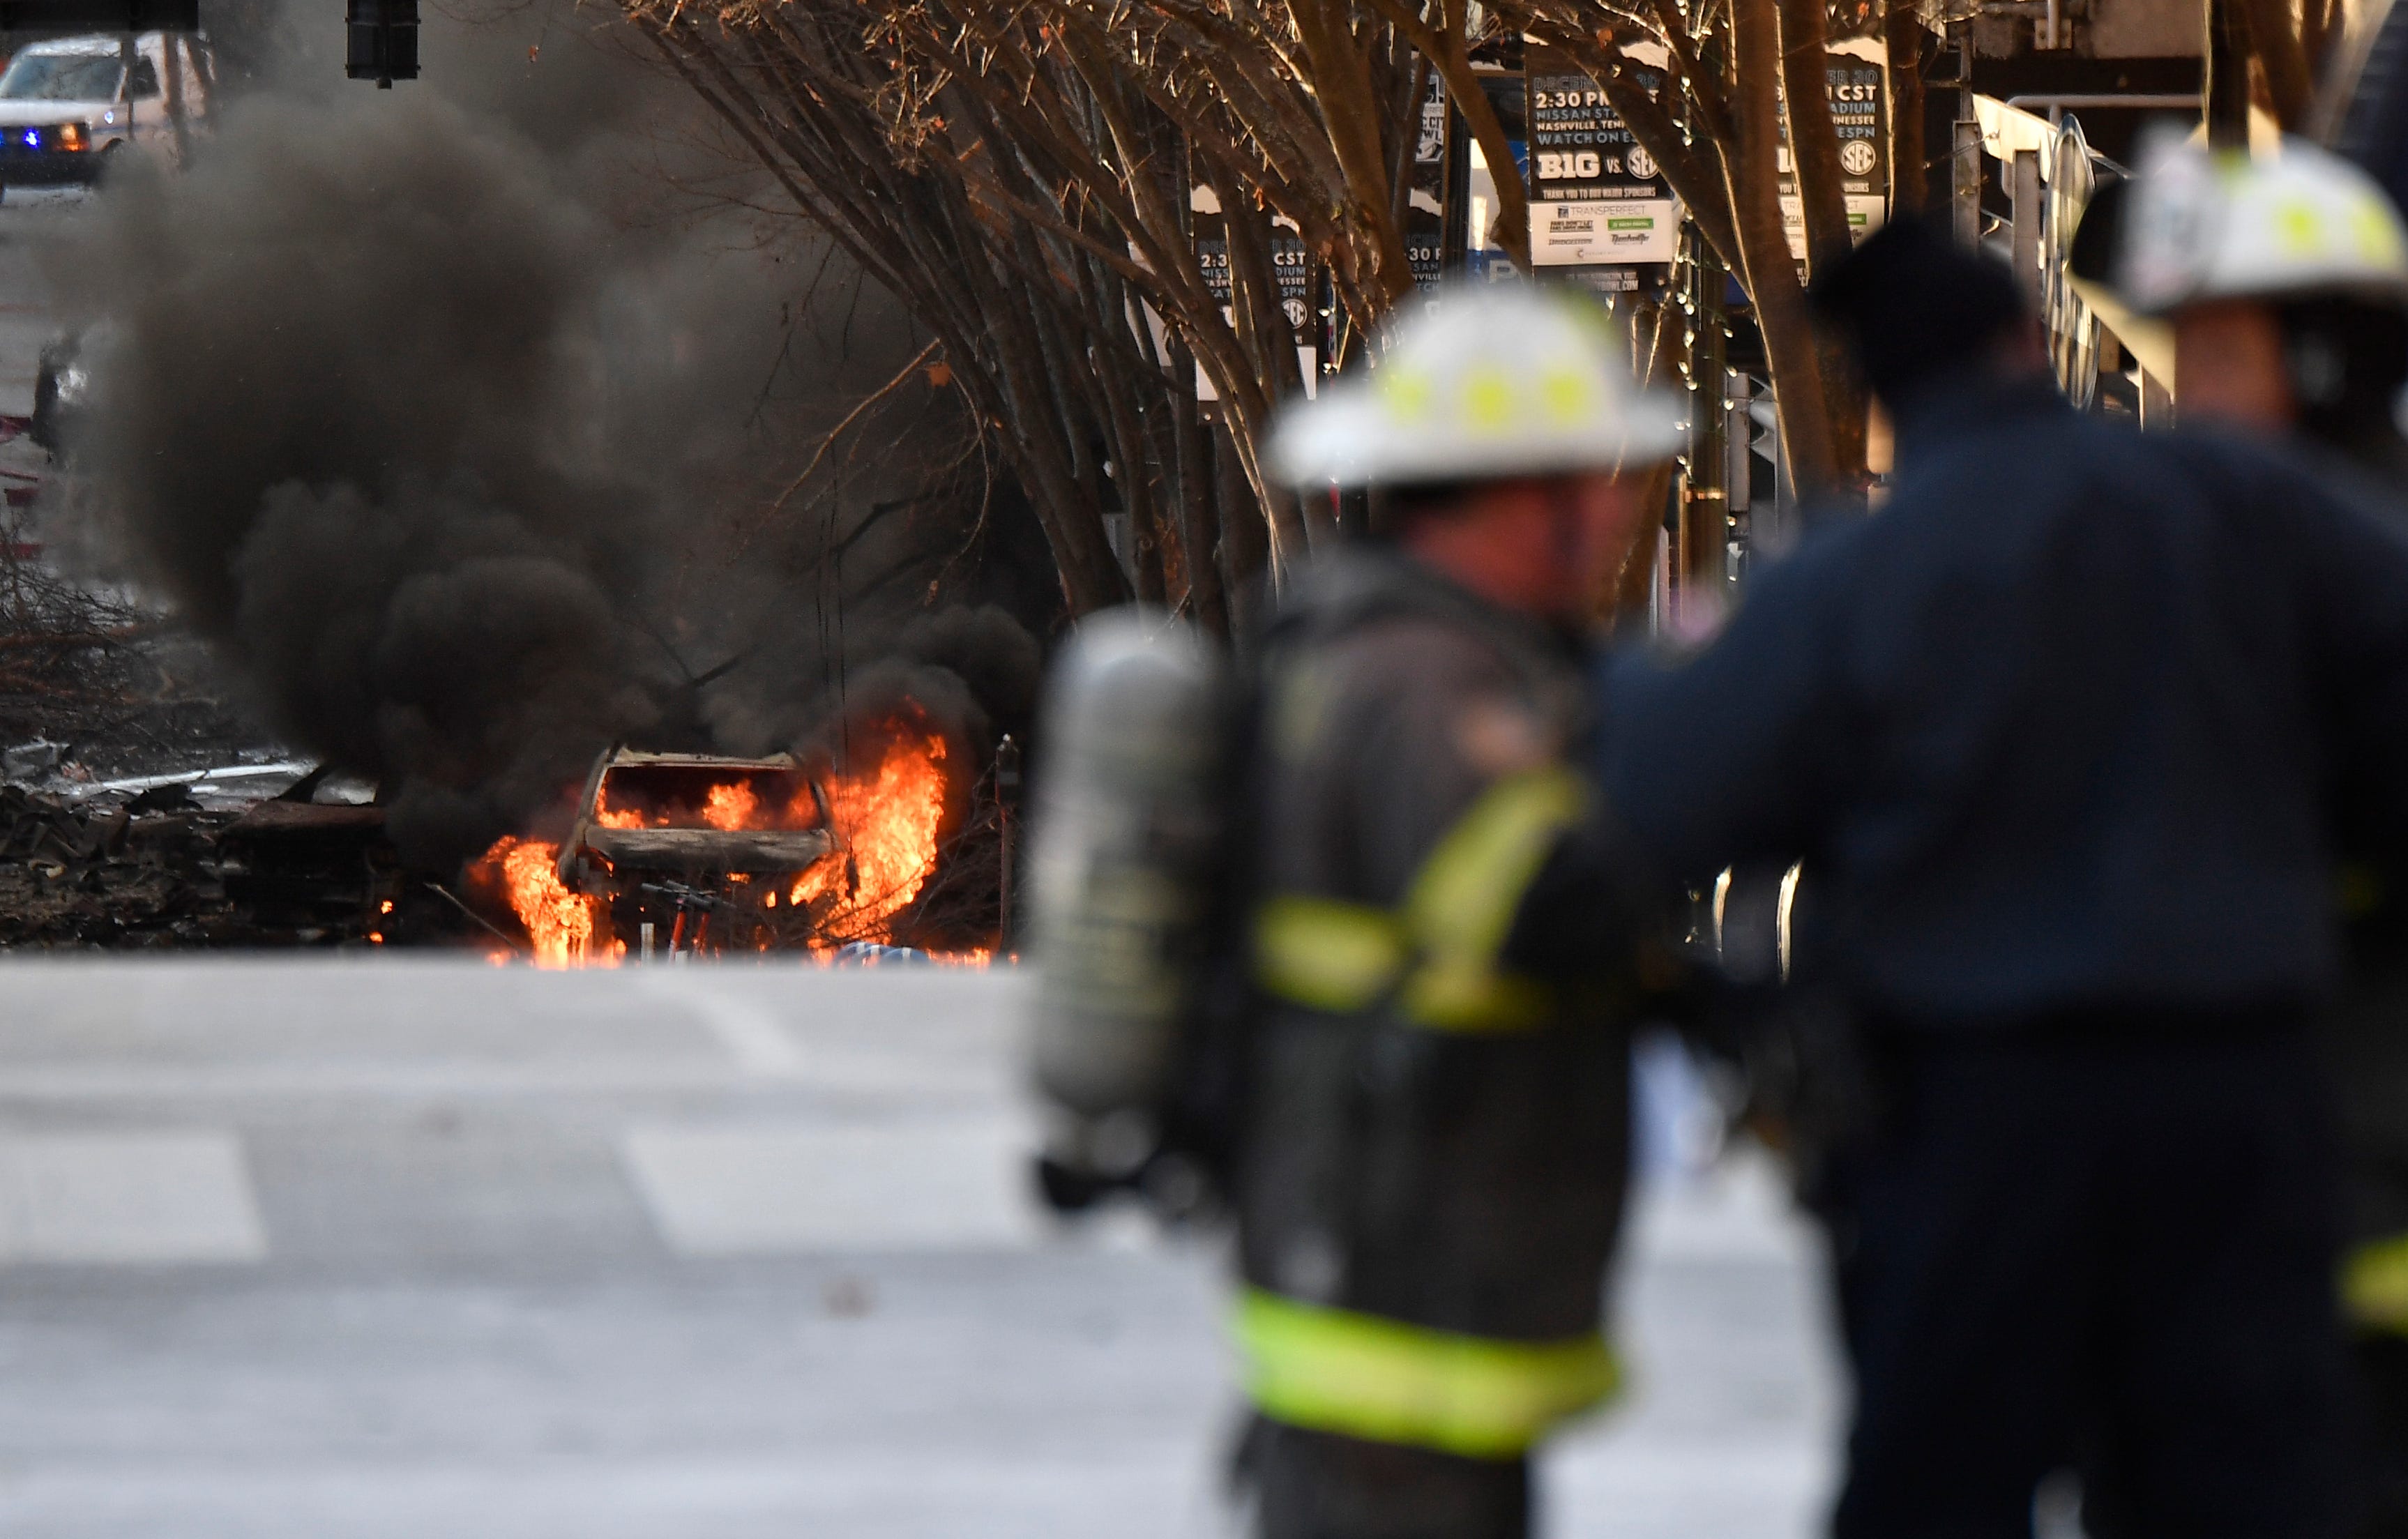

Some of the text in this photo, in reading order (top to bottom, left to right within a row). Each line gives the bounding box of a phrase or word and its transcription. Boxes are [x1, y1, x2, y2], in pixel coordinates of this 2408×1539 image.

[1838, 84, 1877, 101] CST
[1536, 92, 1581, 108] 2:30
[1830, 103, 1876, 114] ADIUM
[1536, 109, 1591, 121] NISSAN
[1832, 115, 1875, 125] NESSEE
[1538, 133, 1592, 146] WATCH
[1597, 131, 1619, 144] ON
[1838, 127, 1875, 139] ESPN
[1845, 144, 1872, 172] SEC
[1543, 190, 1564, 200] THANK
[1566, 189, 1578, 199] YOU
[1580, 188, 1588, 199] TO
[1624, 186, 1656, 197] SPONSORS
[1570, 205, 1646, 216] TRANSPERFECT
[1200, 252, 1306, 268] 2:3 CST
[1404, 247, 1431, 261] 30
[1201, 266, 1306, 278] NISS DIUM
[1413, 263, 1440, 272] SAN
[1278, 277, 1306, 285] ESSEE
[1416, 282, 1440, 292] TCH
[1282, 287, 1306, 298] SPN
